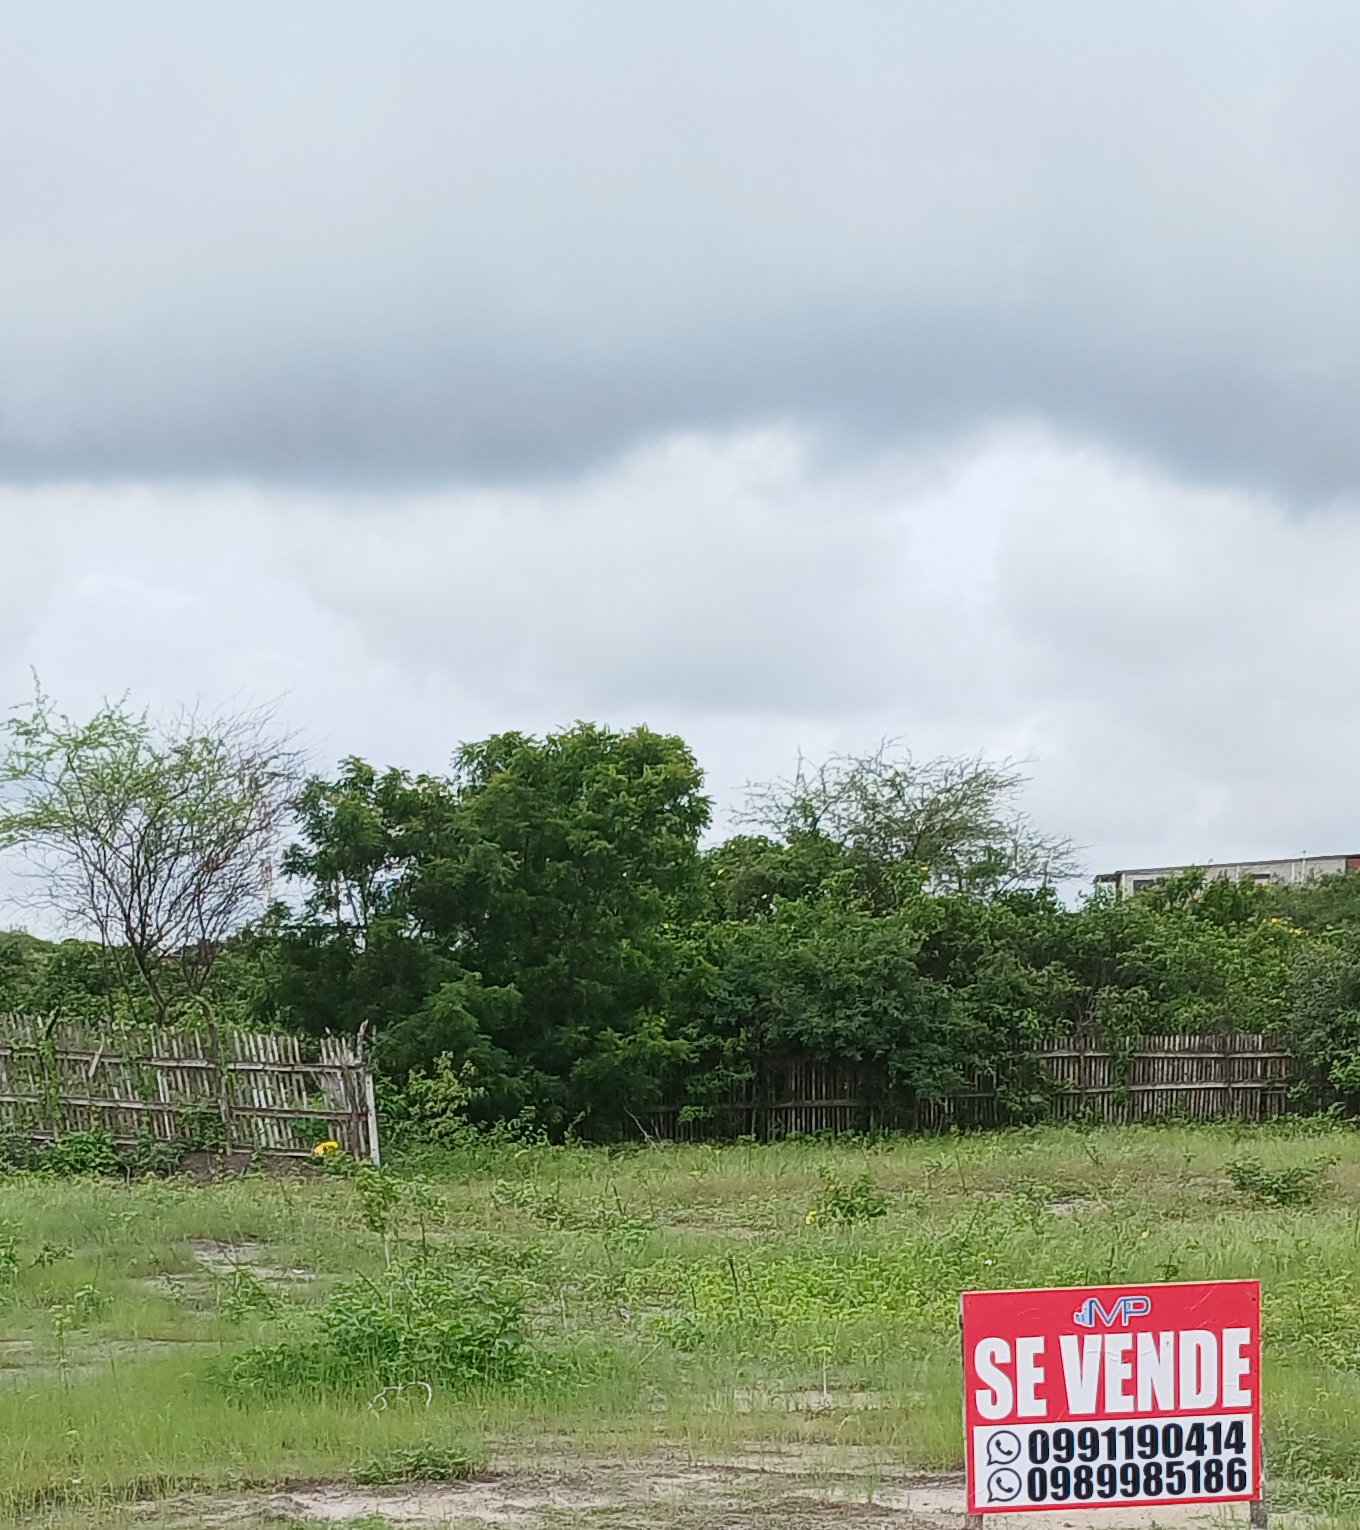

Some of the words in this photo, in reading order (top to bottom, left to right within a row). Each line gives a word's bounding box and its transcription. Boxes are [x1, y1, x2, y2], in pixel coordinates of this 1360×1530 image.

[974, 1336, 1047, 1420] SE
[1059, 1327, 1252, 1415] VENDE
[1028, 1420, 1246, 1464] 0991190414
[1027, 1457, 1247, 1502] 0989985186
